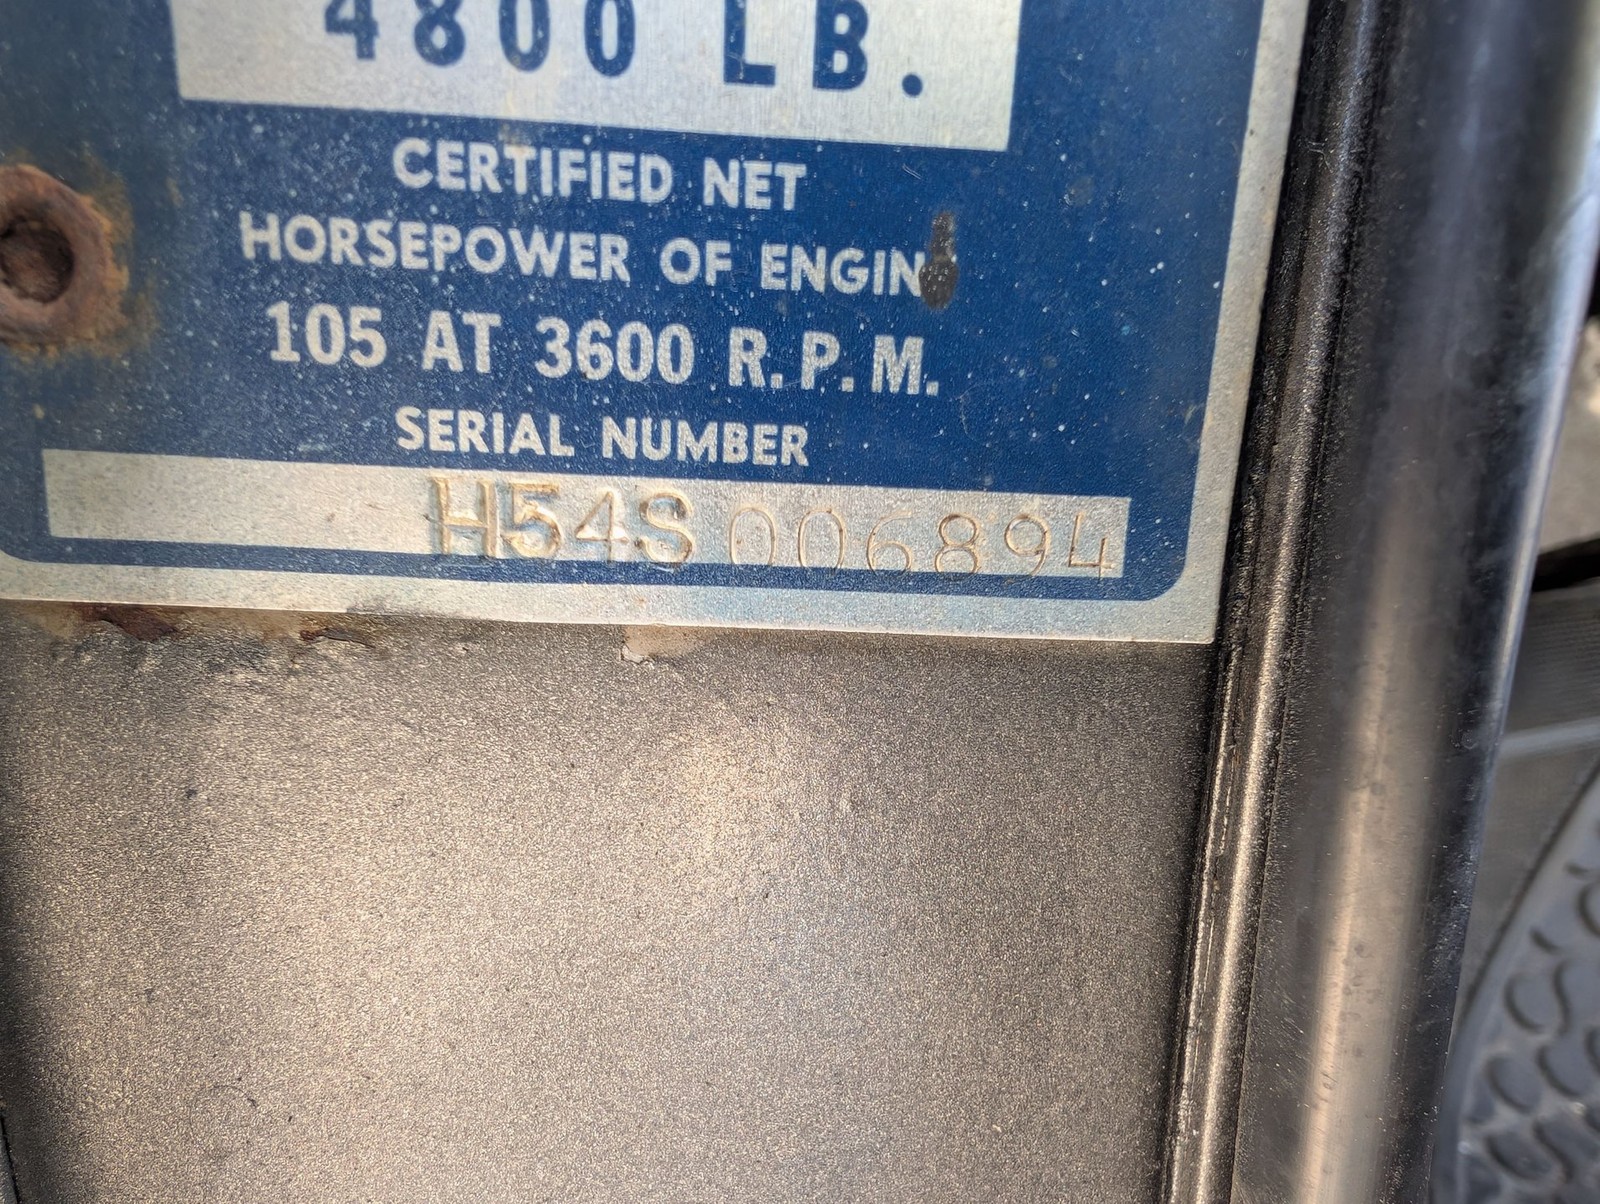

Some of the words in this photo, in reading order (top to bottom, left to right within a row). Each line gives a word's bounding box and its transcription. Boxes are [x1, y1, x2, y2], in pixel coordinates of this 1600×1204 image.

[325, 0, 636, 77] 4800
[392, 137, 673, 204] CERTIFIED
[702, 157, 808, 211] NET
[239, 210, 631, 283] HORSEPOWER
[659, 237, 732, 287] OF
[760, 243, 953, 299] ENGIN
[266, 300, 388, 368] 105
[421, 309, 503, 374] AT
[534, 317, 695, 384] 3600
[394, 406, 576, 458] SERIAL
[601, 417, 810, 468] NUMBER
